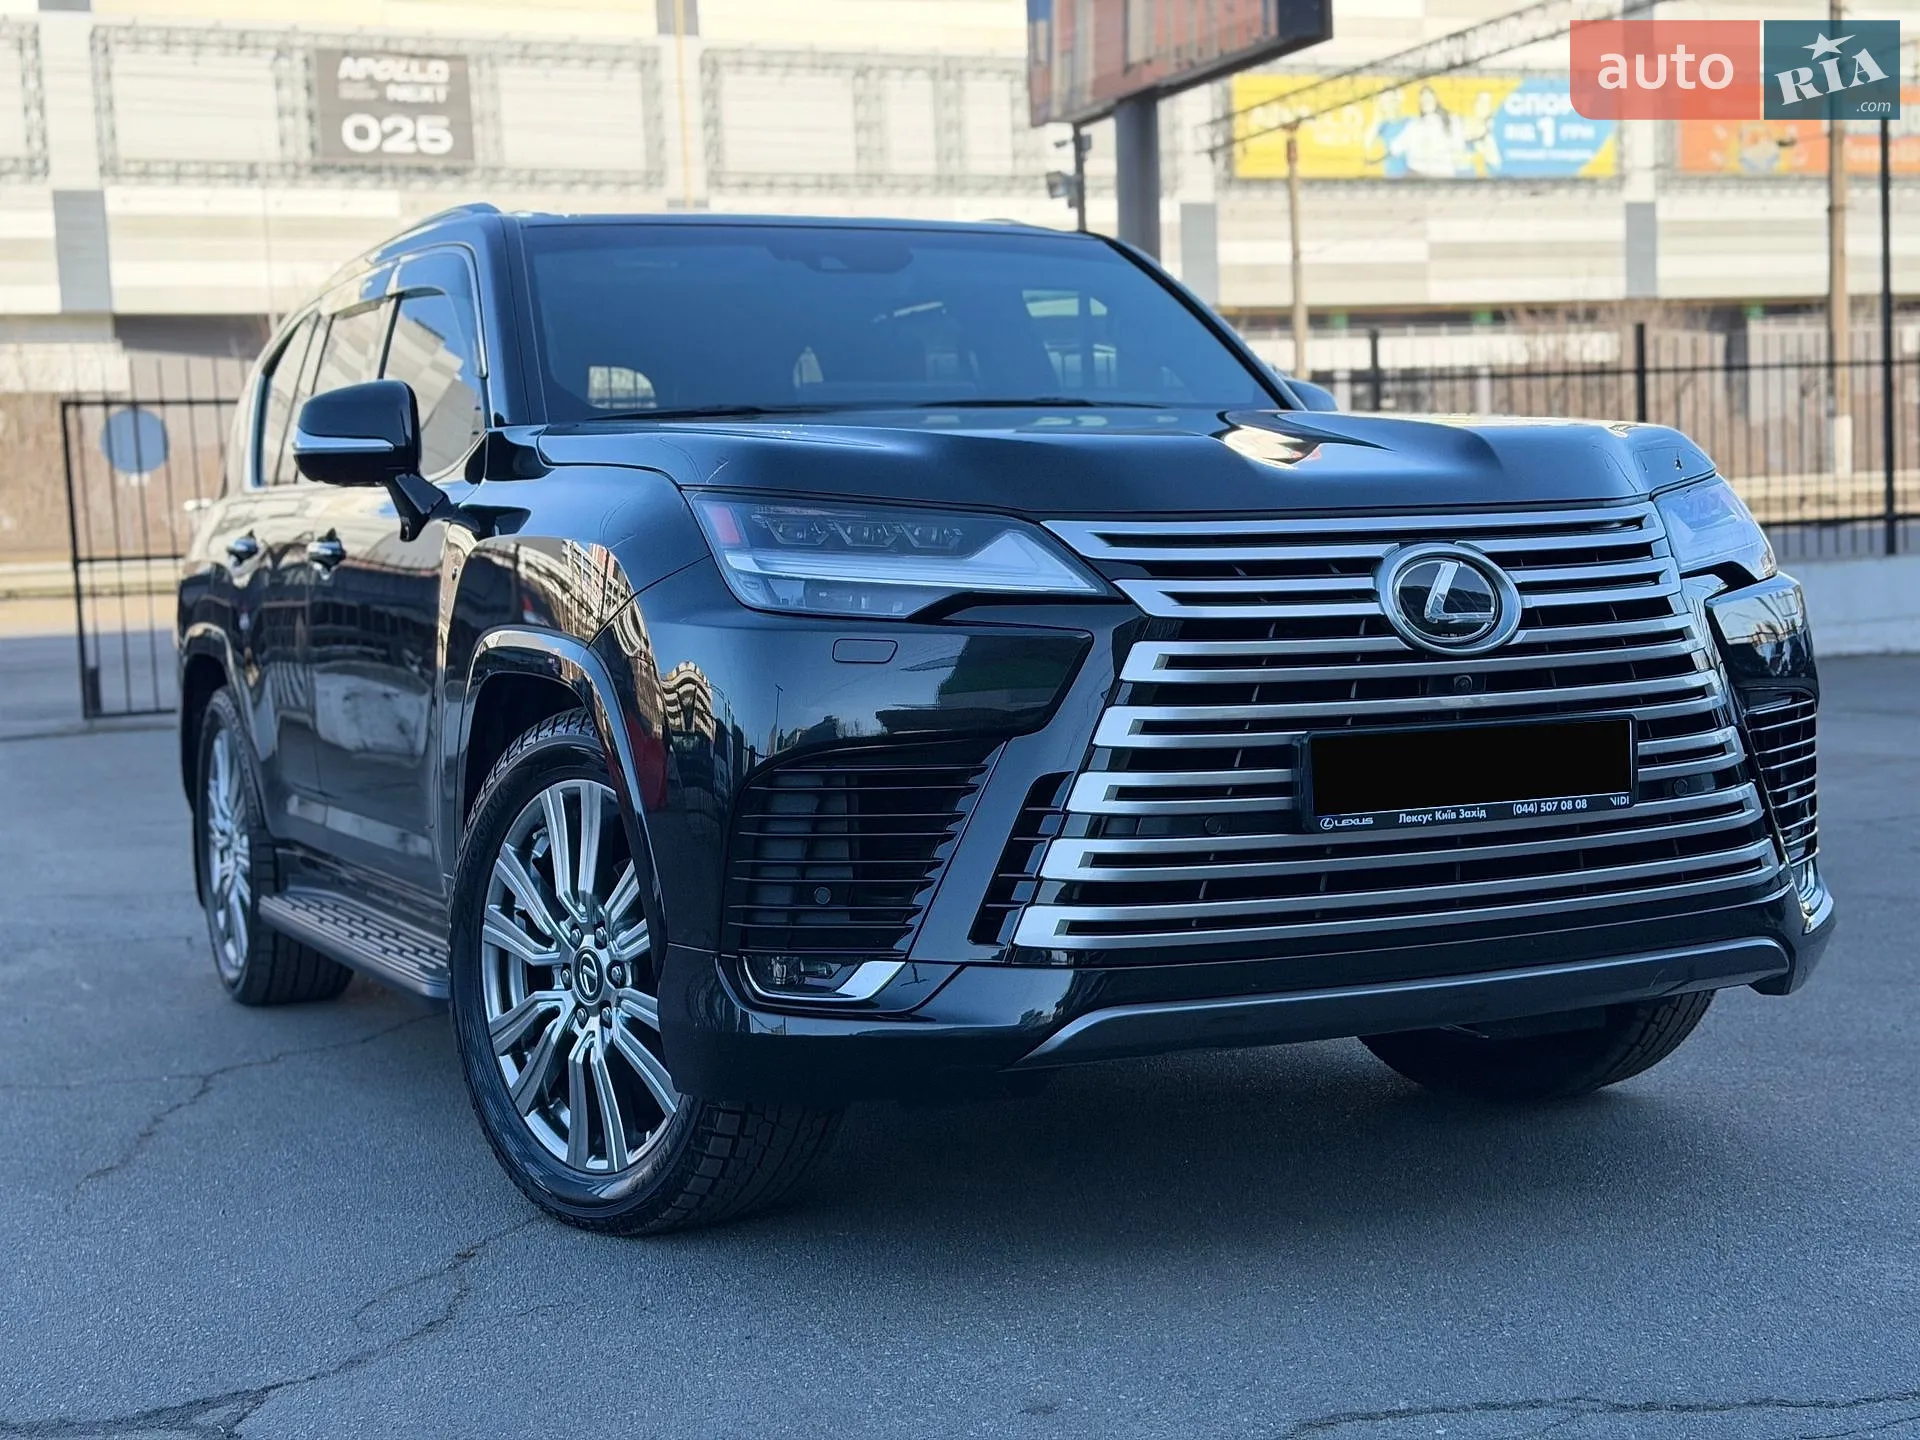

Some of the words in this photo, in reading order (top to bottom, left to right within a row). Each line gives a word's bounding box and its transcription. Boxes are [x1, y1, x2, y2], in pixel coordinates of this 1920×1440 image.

[341, 113, 454, 154] 025
[1513, 803, 1538, 816] (044)
[1540, 802, 1558, 812] 507
[1561, 800, 1573, 811] 08
[1576, 799, 1588, 810] 08
[1610, 796, 1630, 806] VIDI
[1335, 817, 1374, 827] LEXUS
[1398, 811, 1433, 825] Лексус
[1435, 808, 1457, 821] Київ
[1459, 805, 1487, 820] Захід
